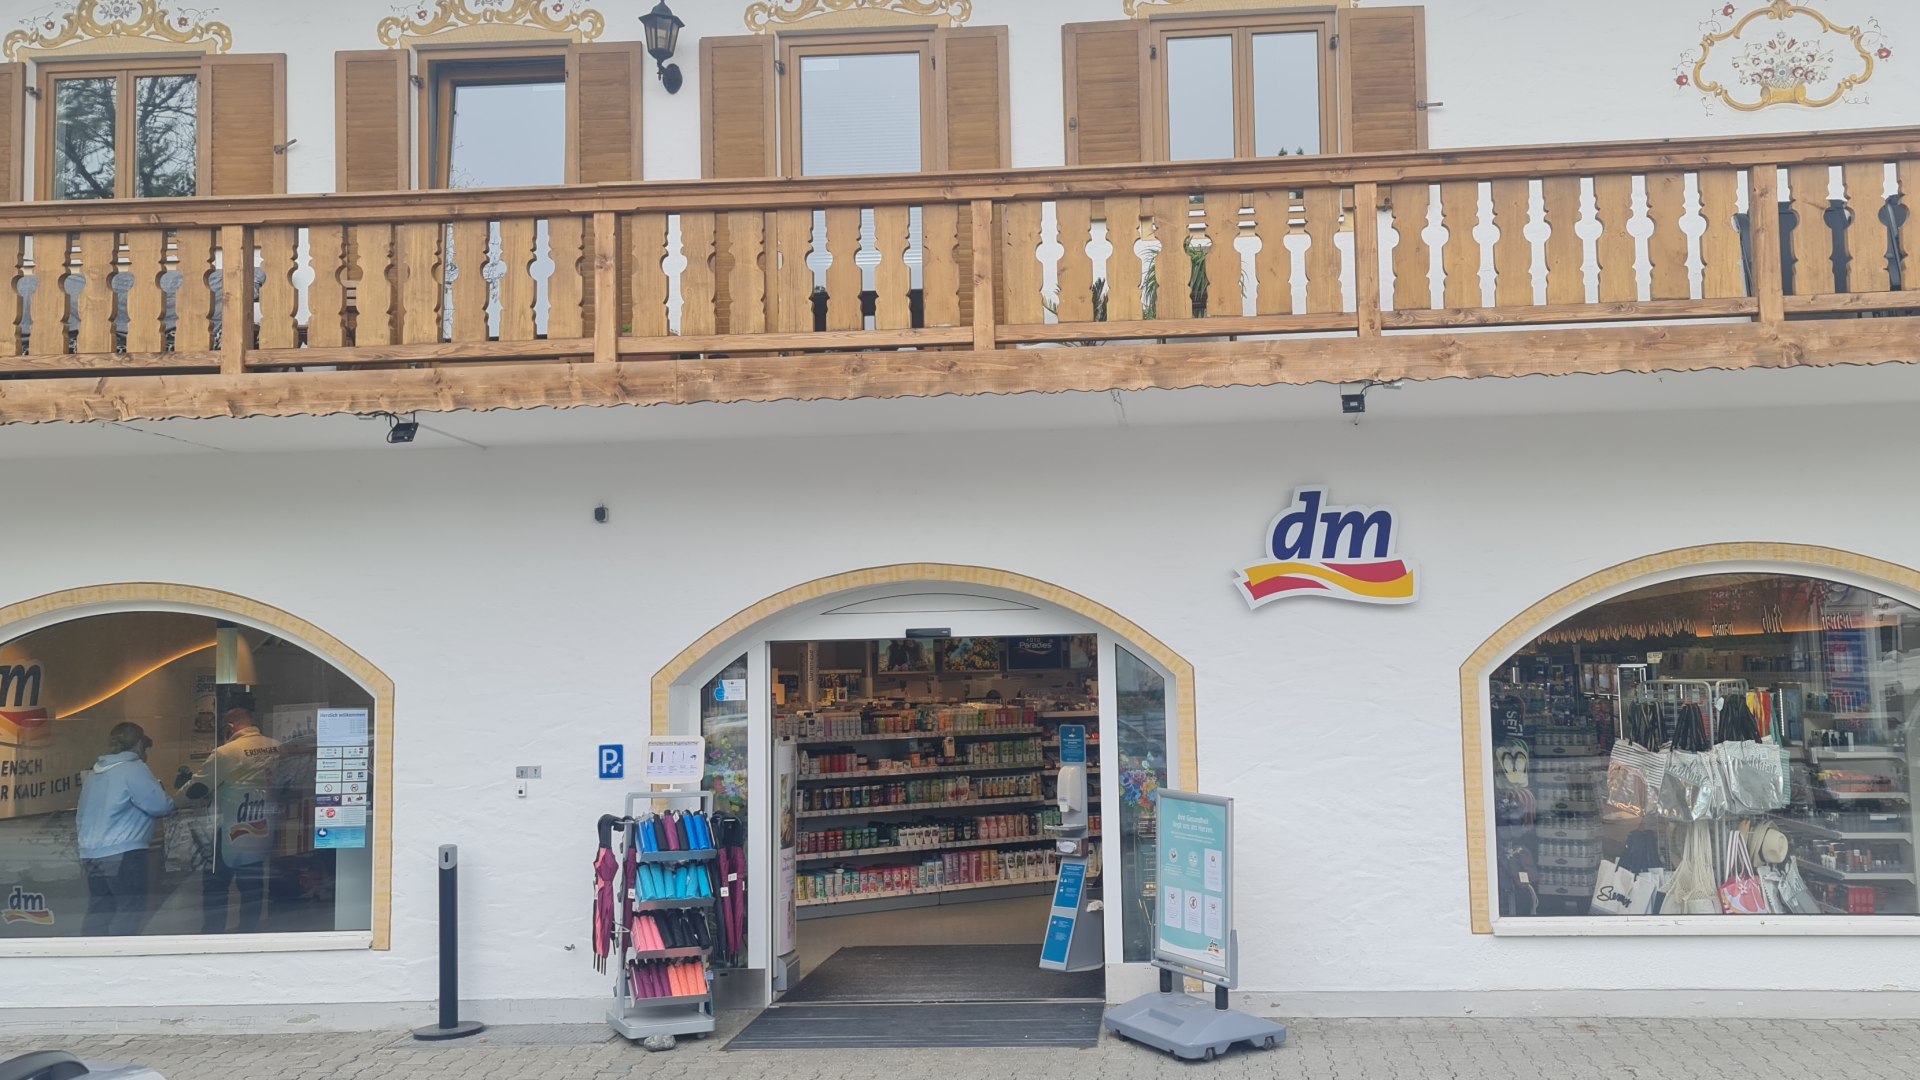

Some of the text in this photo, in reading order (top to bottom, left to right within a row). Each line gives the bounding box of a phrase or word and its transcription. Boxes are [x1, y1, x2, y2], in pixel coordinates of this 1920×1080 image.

[1272, 490, 1392, 560] dm
[1019, 641, 1052, 649] Paradies
[602, 748, 618, 774] P
[14, 782, 46, 799] KAUF
[51, 776, 70, 794] ICH
[237, 792, 265, 823] dm
[10, 888, 44, 910] dm
